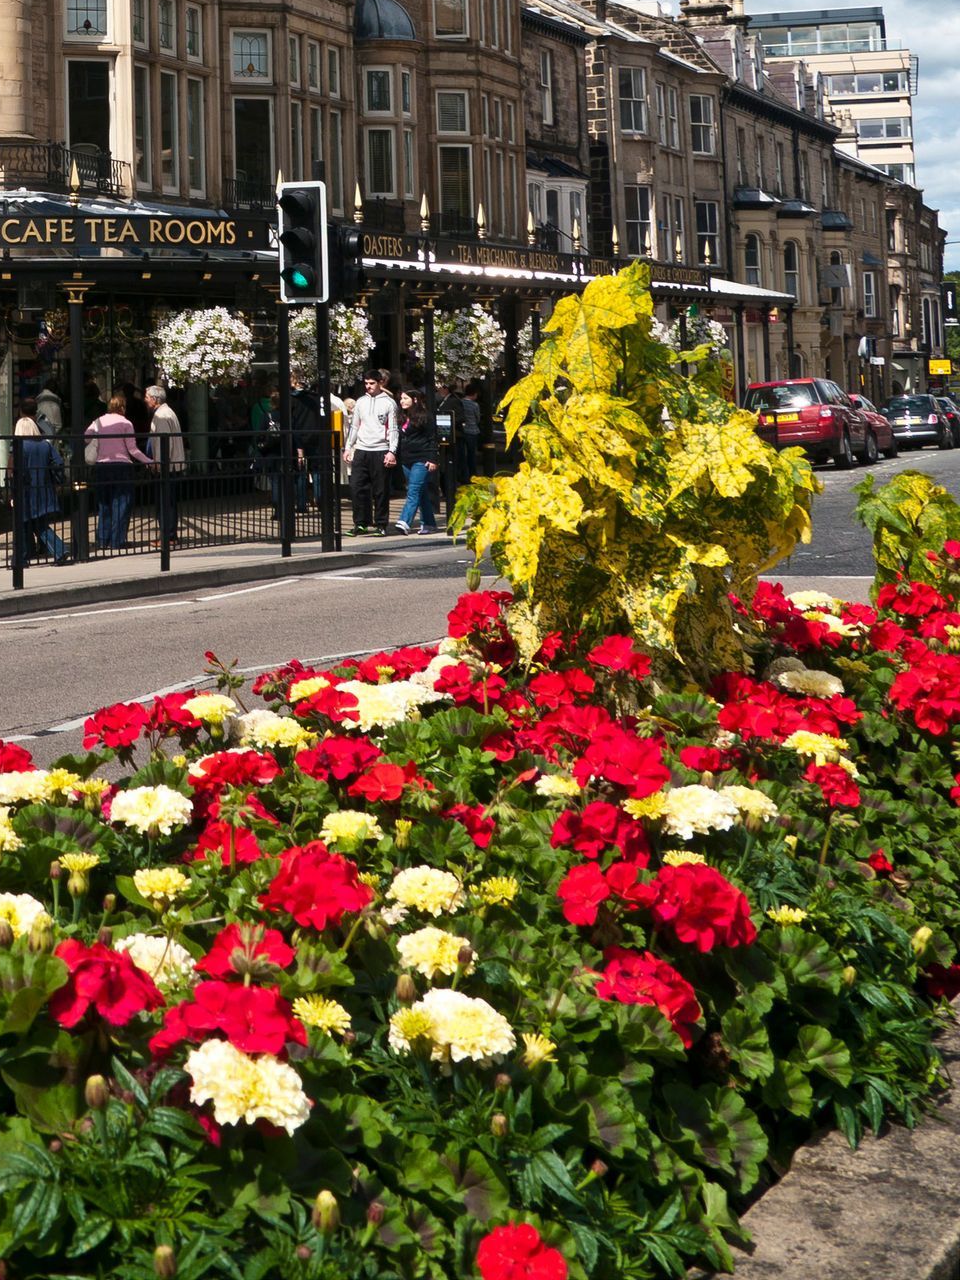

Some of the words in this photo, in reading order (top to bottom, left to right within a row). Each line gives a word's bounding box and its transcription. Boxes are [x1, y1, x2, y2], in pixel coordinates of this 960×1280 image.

[1, 218, 76, 244] CAFE
[84, 218, 140, 243] TEA
[149, 219, 236, 245] ROOMS
[363, 234, 403, 257] OASTERS
[457, 245, 473, 264] TEA
[476, 248, 518, 268] MERCHANTS
[520, 255, 526, 268] &
[529, 253, 559, 271] BLENDERS
